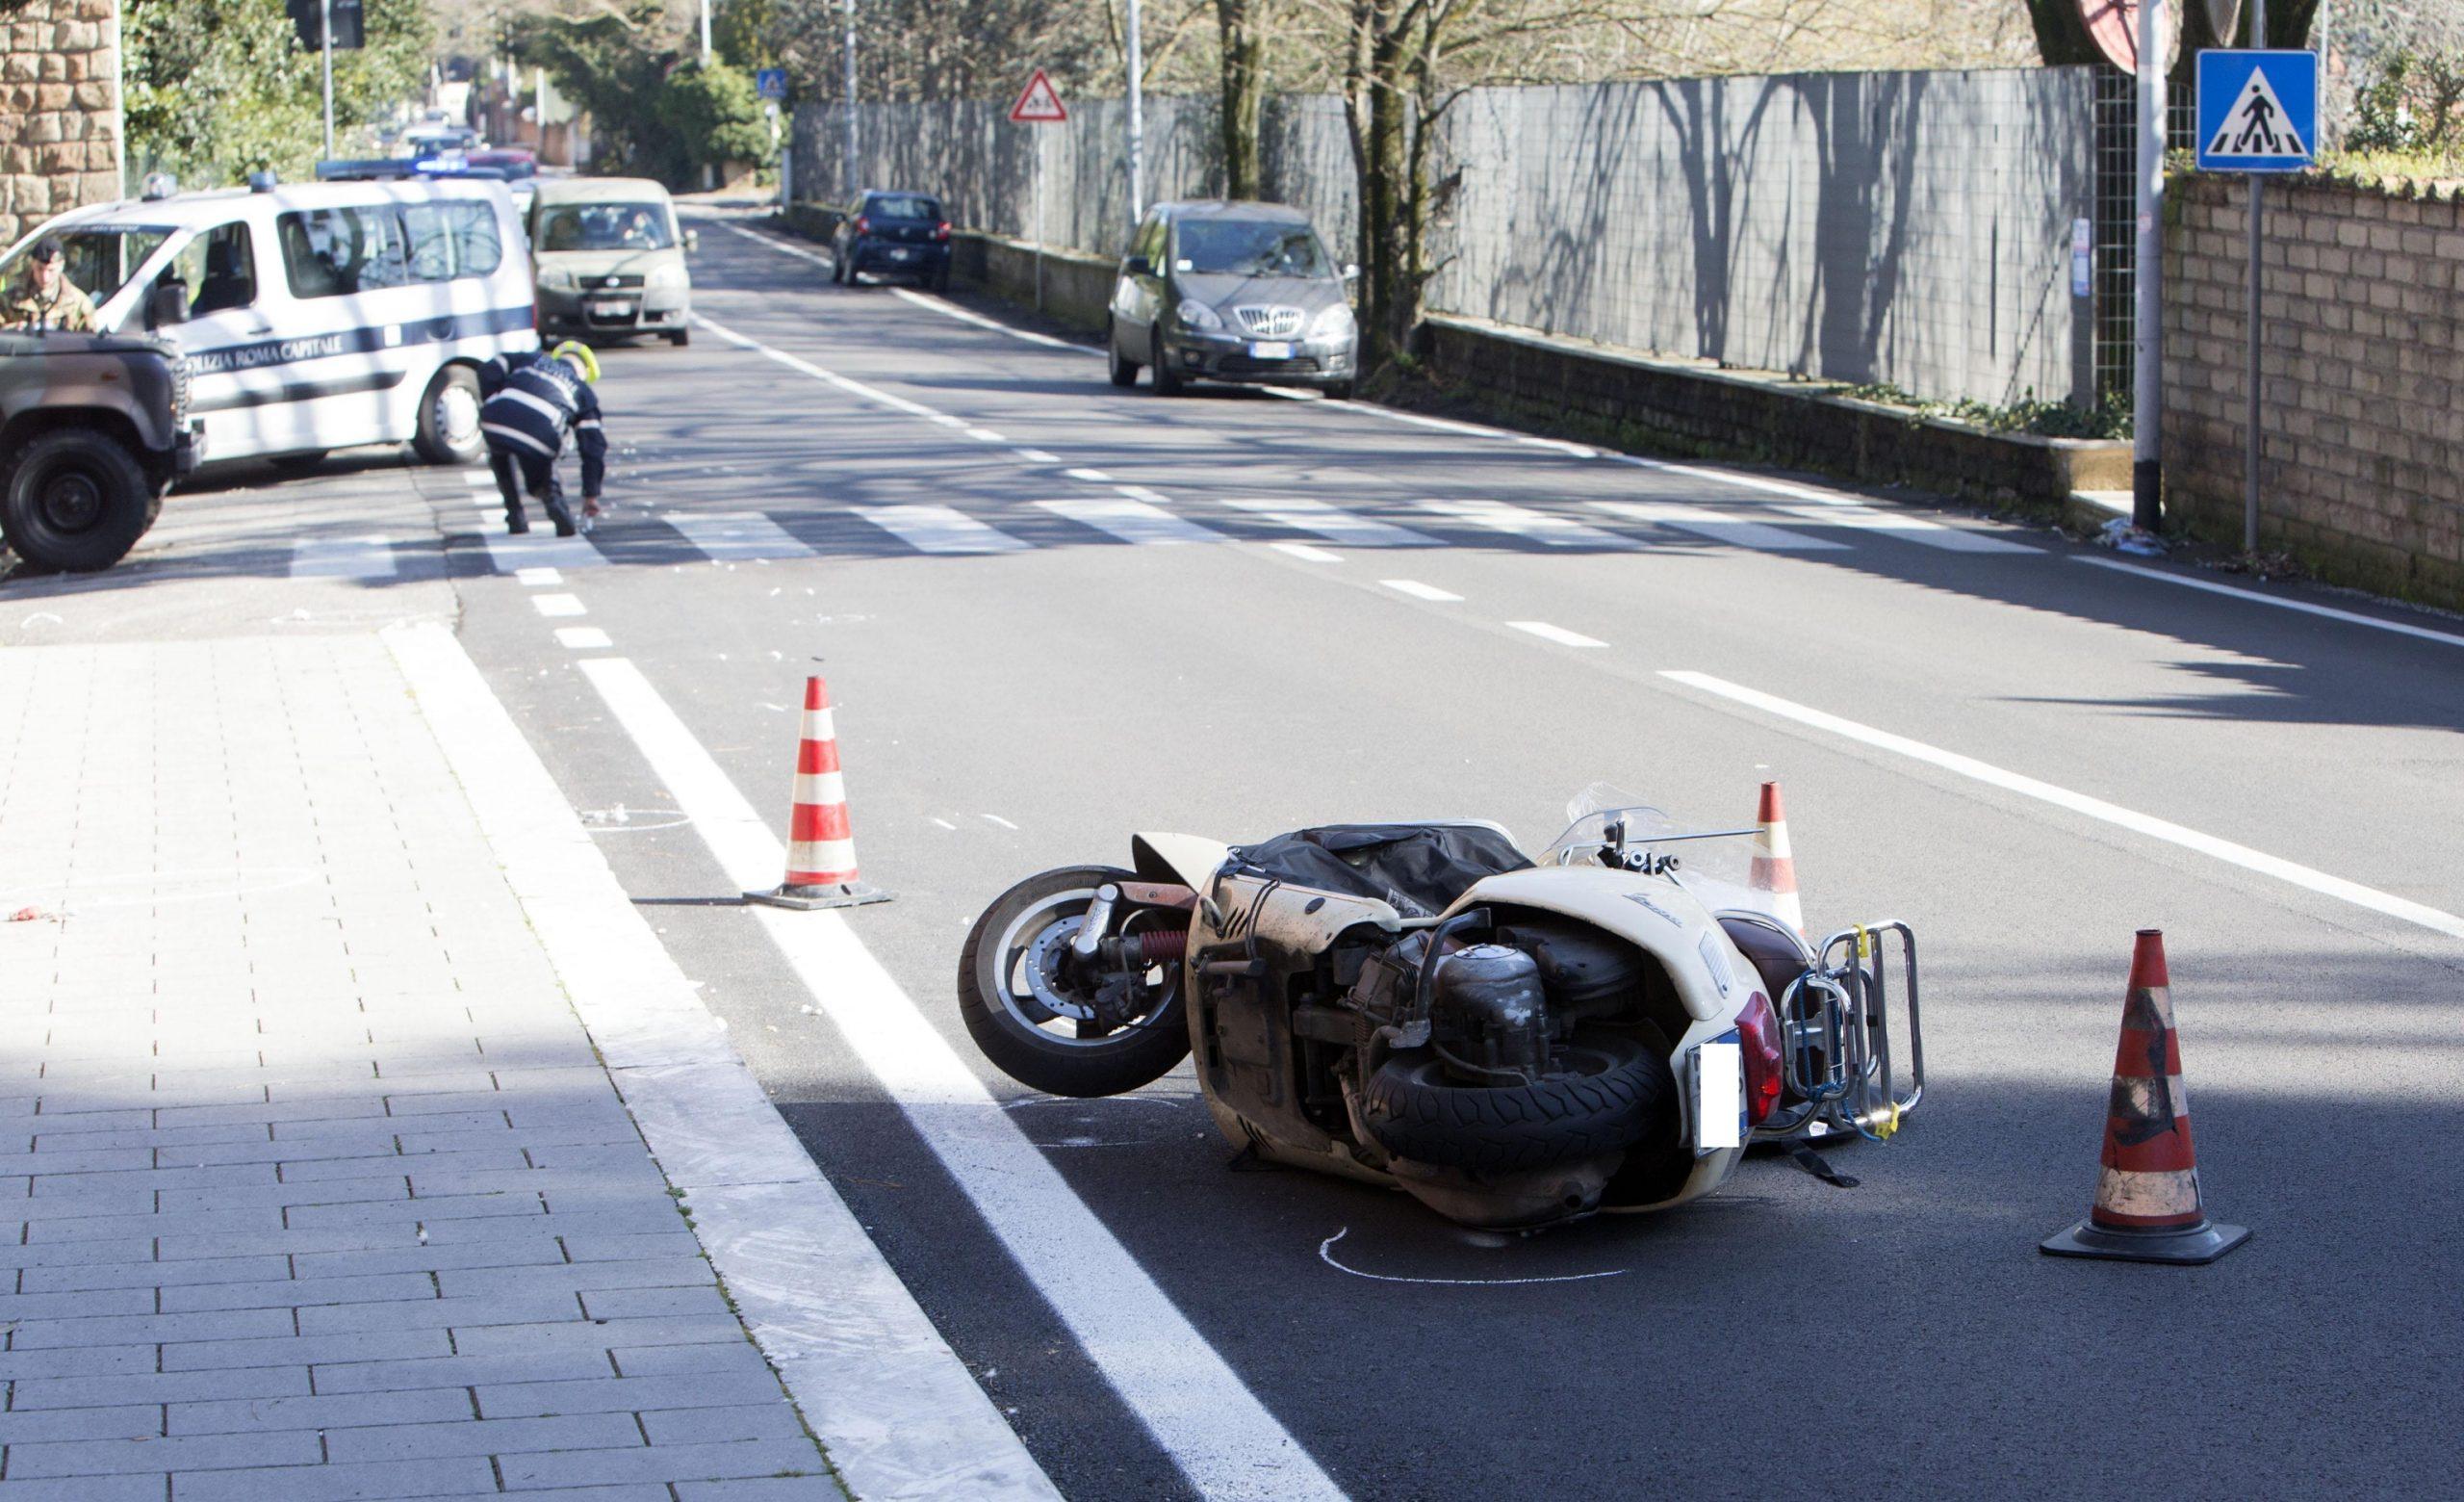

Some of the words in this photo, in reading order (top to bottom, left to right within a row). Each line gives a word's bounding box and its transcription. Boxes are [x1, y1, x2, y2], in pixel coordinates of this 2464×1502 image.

[186, 352, 233, 372] OLIZIA
[235, 346, 280, 367] ROMA
[280, 335, 343, 360] CAPITALE
